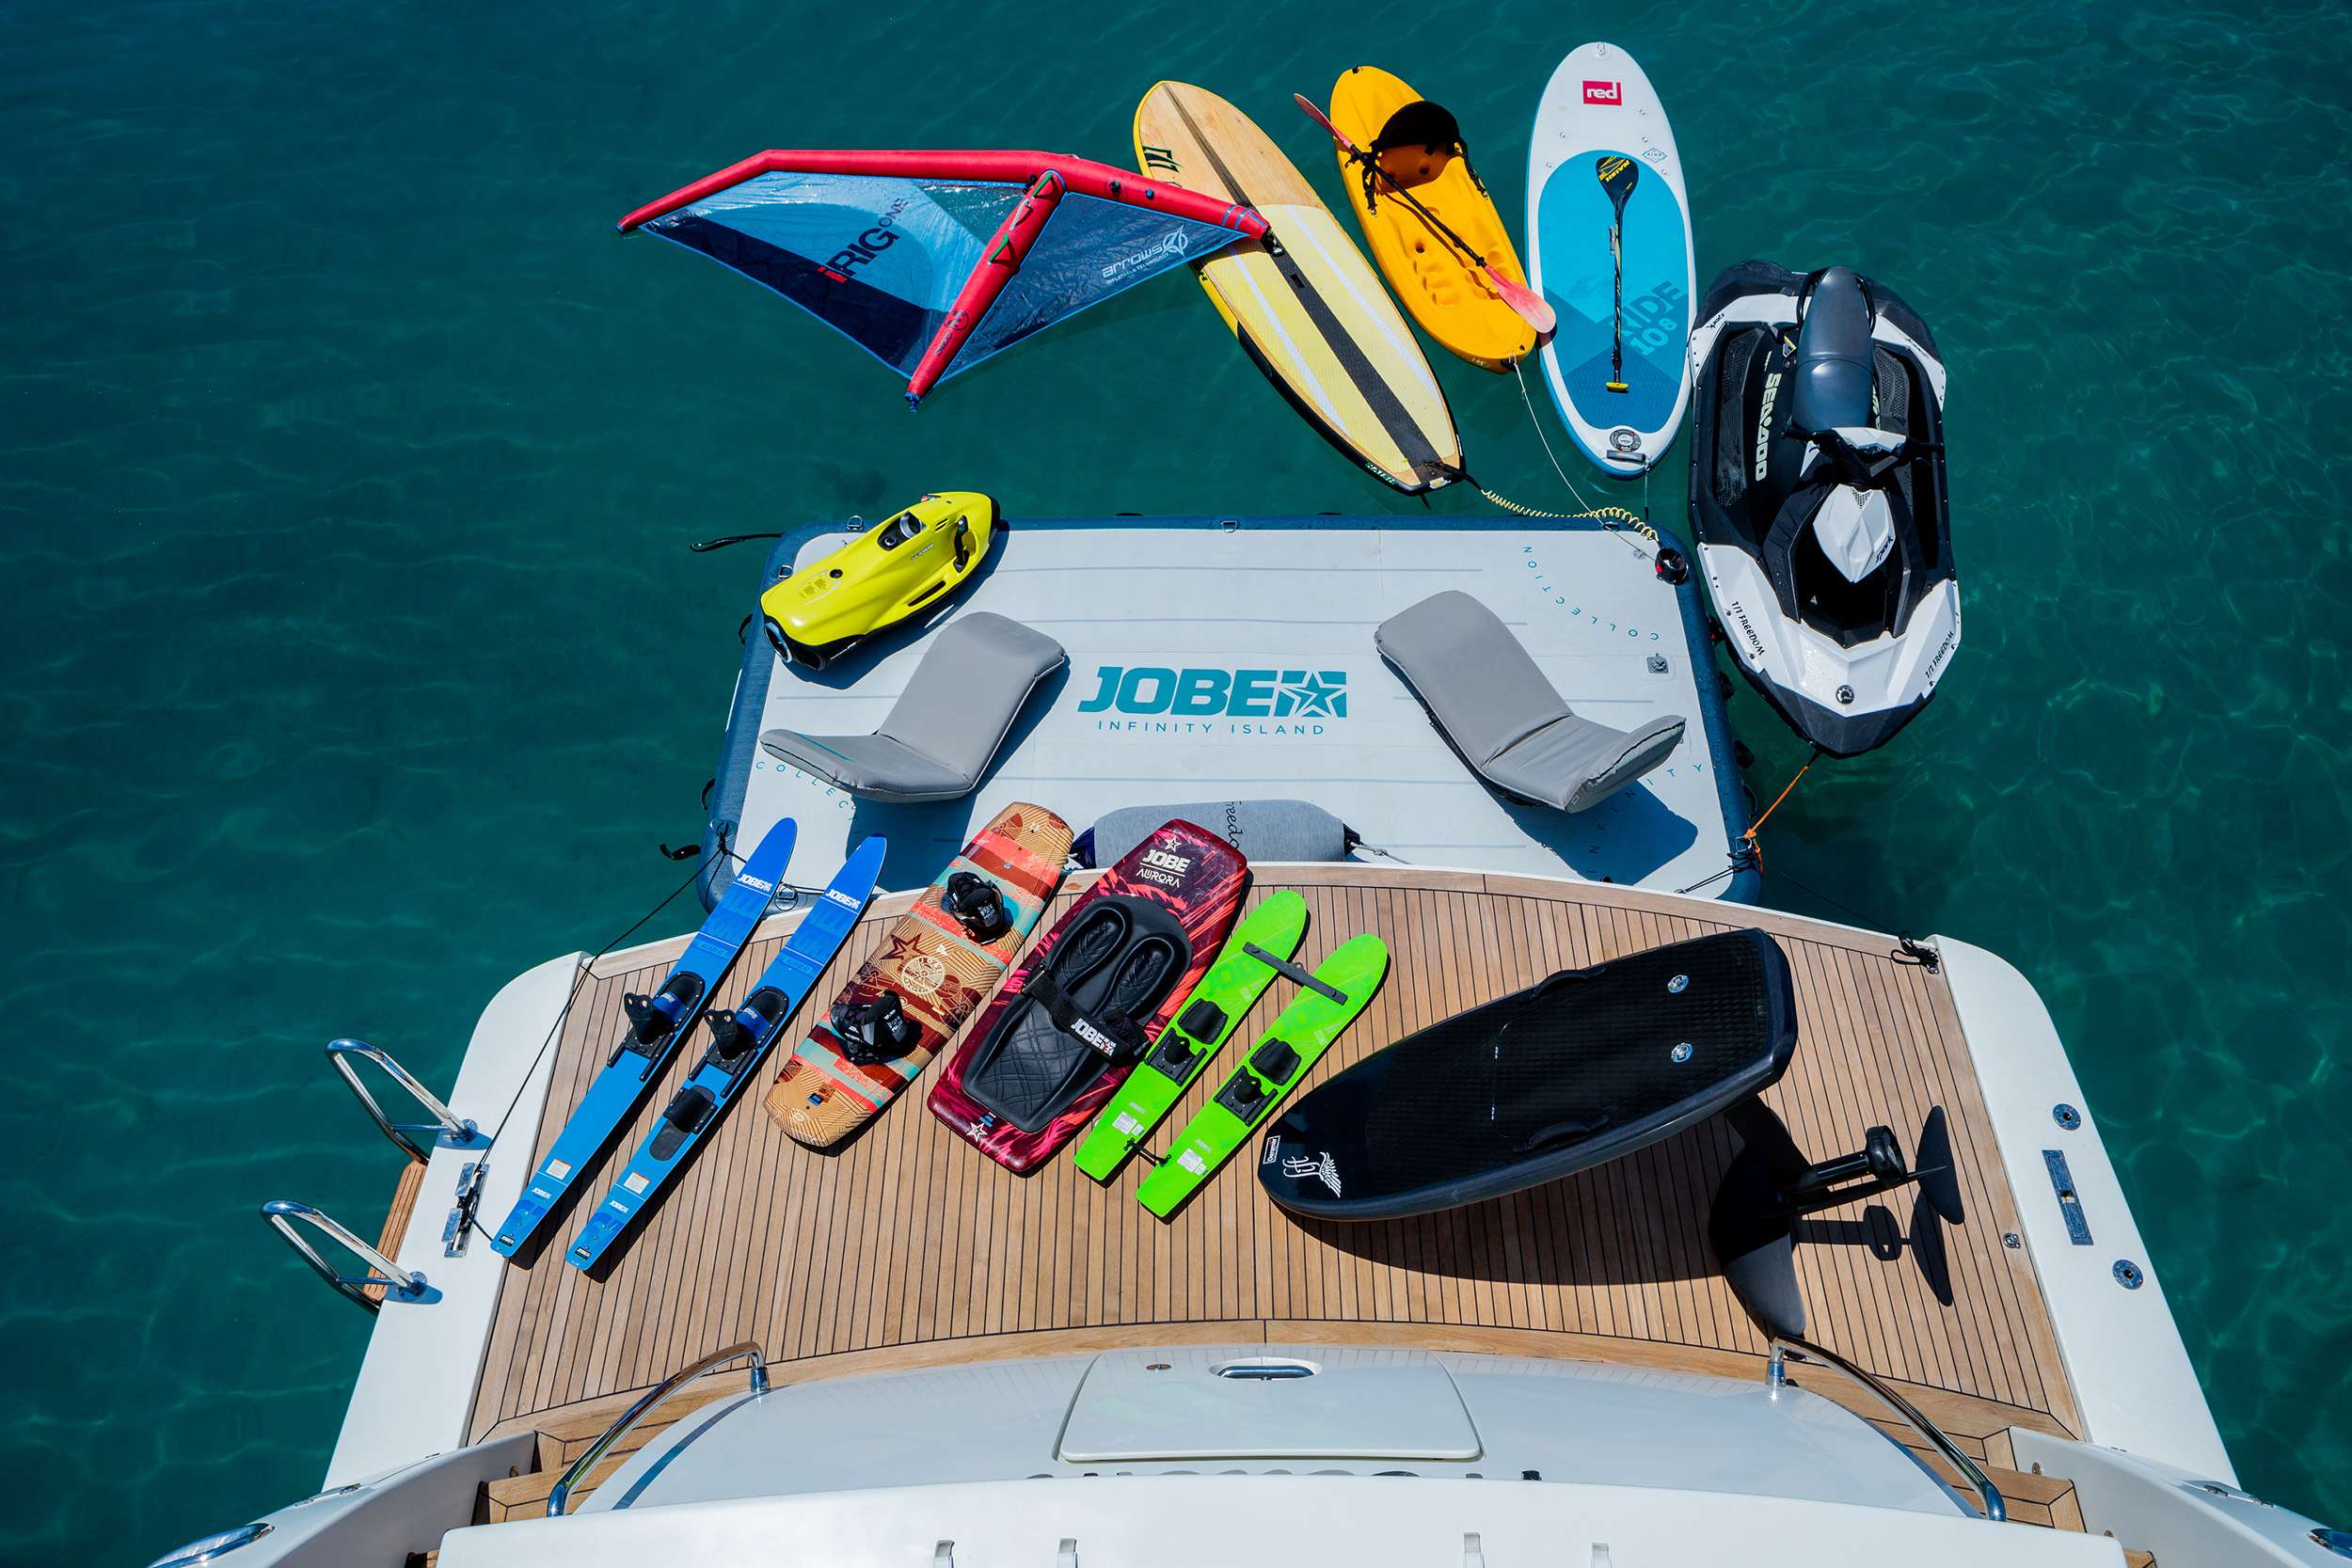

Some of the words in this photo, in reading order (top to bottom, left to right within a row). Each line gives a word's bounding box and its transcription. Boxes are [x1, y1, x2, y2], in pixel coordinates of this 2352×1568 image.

[1586, 81, 1618, 99] red
[1077, 666, 1278, 717] JOBE
[1098, 721, 1212, 733] INFINITY
[1231, 723, 1325, 736] ISLAND
[1142, 849, 1191, 873] JOBE
[737, 874, 766, 891] JOBE
[1136, 868, 1180, 888] AURORA
[825, 889, 854, 907] JOBE
[1071, 1018, 1105, 1051] JOBE
